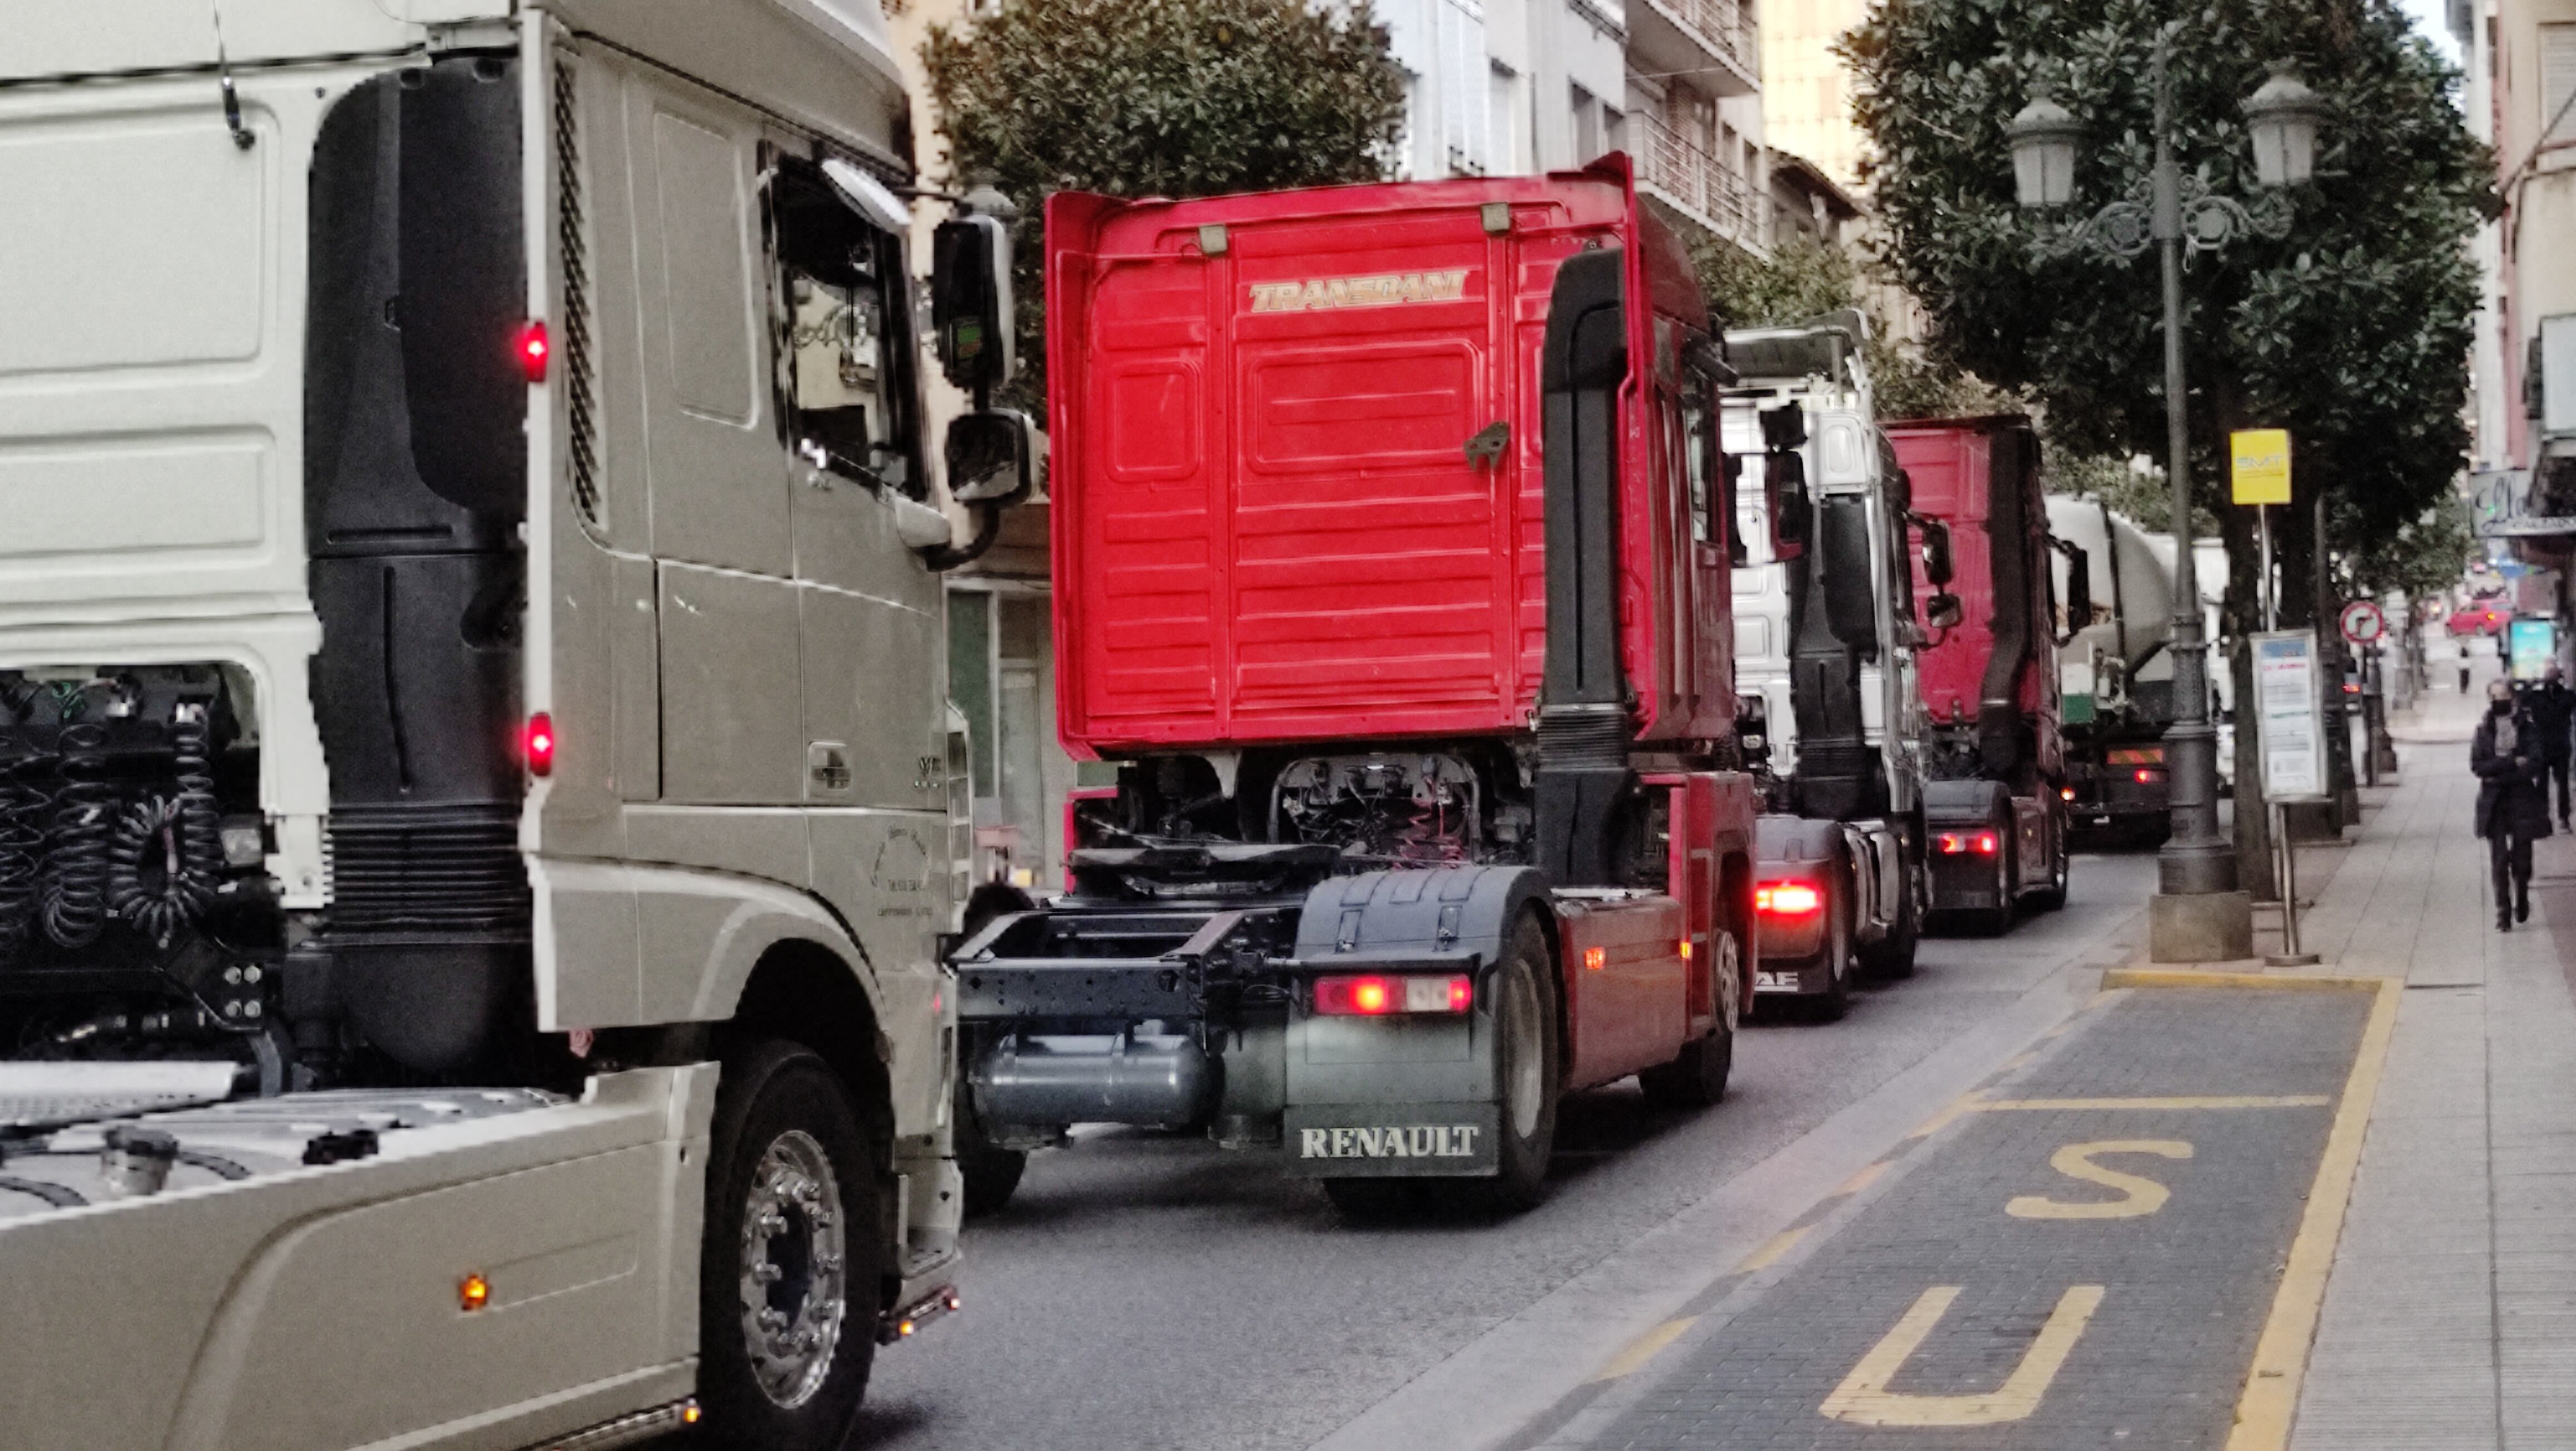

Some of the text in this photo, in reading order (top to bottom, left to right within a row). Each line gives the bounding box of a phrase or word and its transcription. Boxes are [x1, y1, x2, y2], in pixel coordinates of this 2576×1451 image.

[1300, 1126, 1479, 1158] RENAULT
[2006, 1139, 2194, 1219] S
[1818, 1286, 2106, 1426] U
